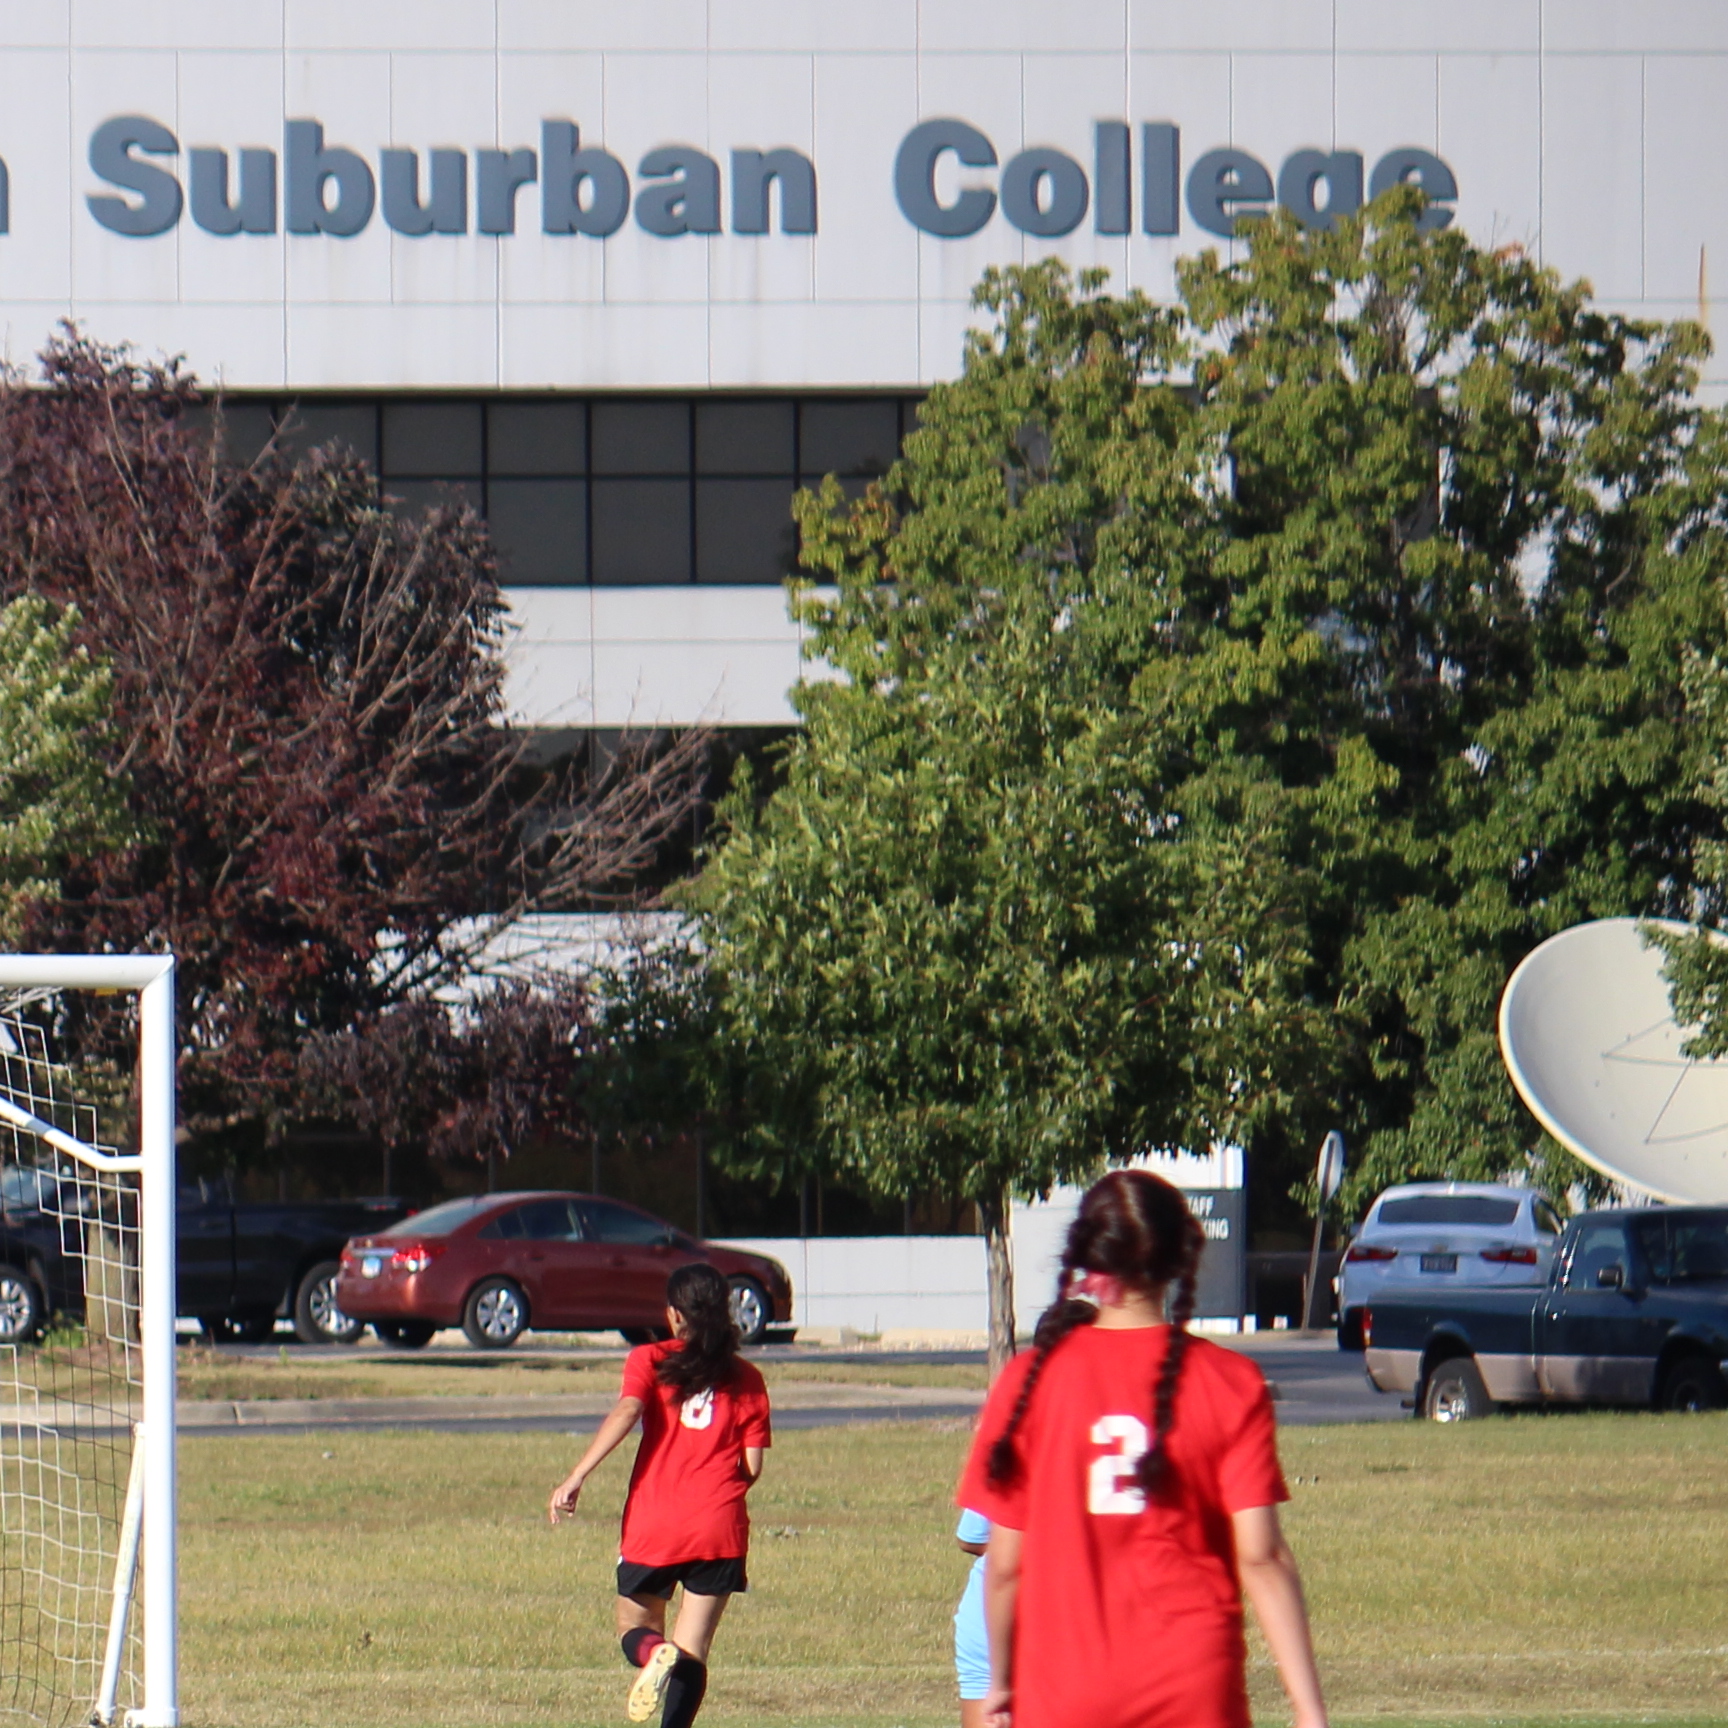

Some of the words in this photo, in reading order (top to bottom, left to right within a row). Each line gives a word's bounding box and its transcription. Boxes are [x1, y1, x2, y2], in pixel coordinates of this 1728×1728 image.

[85, 113, 818, 237] Suburban
[894, 117, 1459, 238] College
[1187, 1195, 1214, 1216] TAFF
[1088, 1414, 1148, 1515] 2
